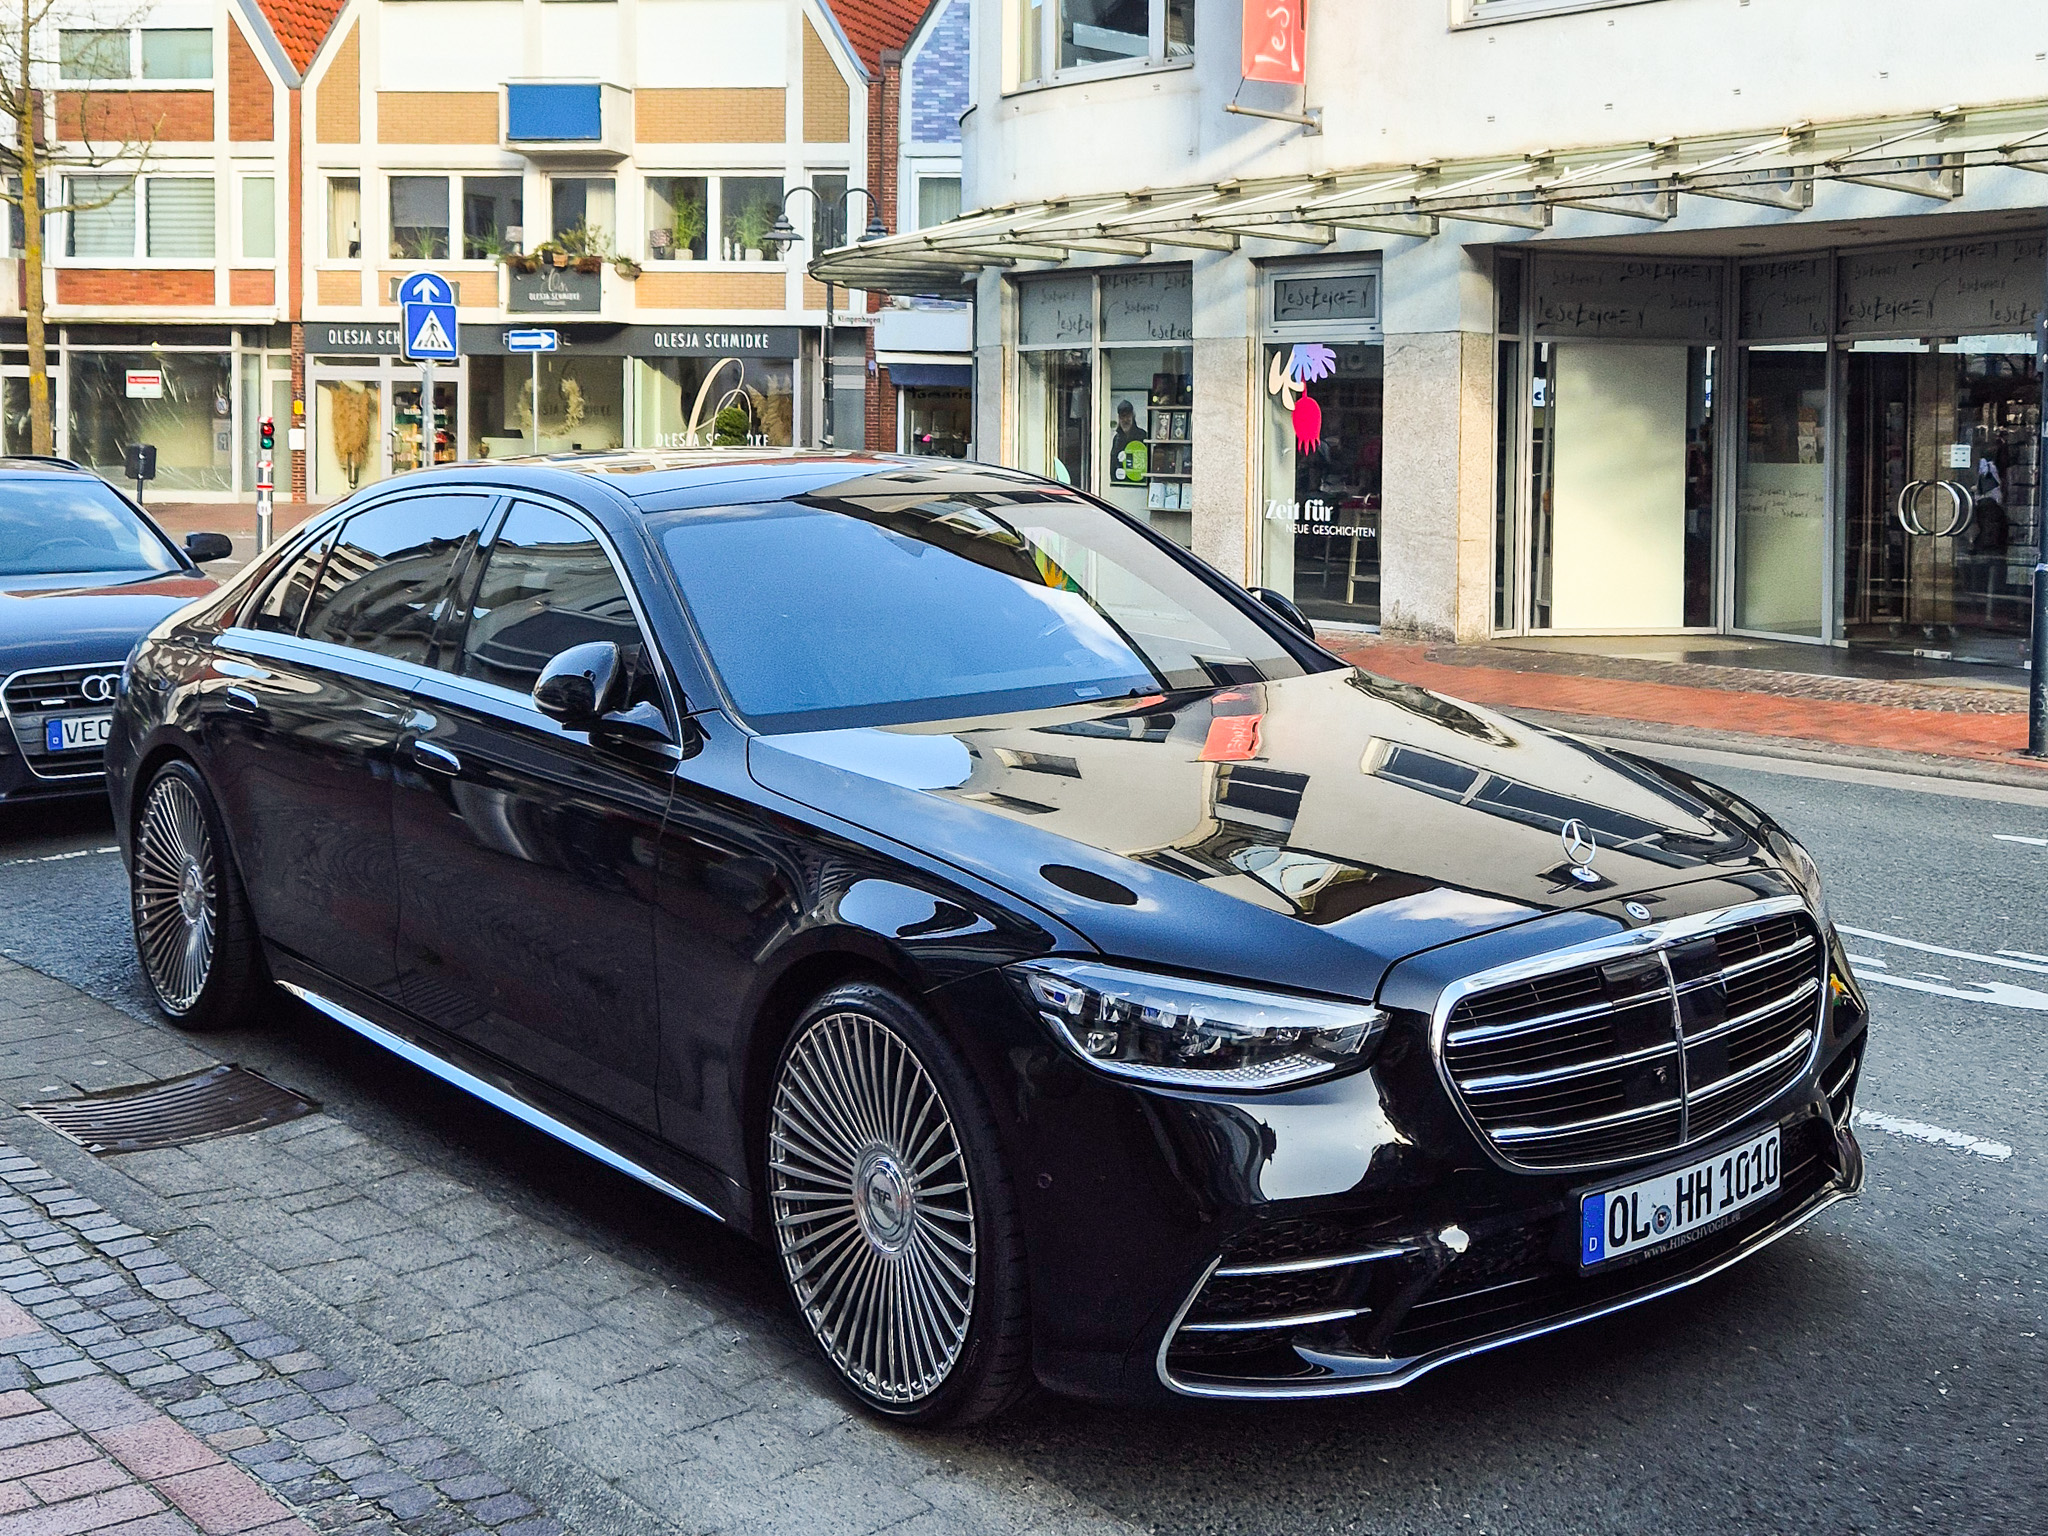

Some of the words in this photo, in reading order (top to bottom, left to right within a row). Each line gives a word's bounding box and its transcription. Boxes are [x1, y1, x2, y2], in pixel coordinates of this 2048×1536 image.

[837, 315, 881, 325] Klingenhagen
[328, 329, 372, 345] OLESJA
[654, 332, 699, 348] OLESJA
[704, 333, 770, 349] SCHMIDKE
[655, 432, 700, 447] OLESA
[1264, 498, 1300, 520] Zeit
[1304, 499, 1334, 522] für
[1285, 523, 1310, 535] NEUE
[1312, 524, 1376, 538] GESCHICHTEN
[1609, 1191, 1650, 1248] OL
[1676, 1166, 1713, 1227] HH
[1720, 1136, 1778, 1210] 1010
[1589, 1237, 1598, 1252] D
